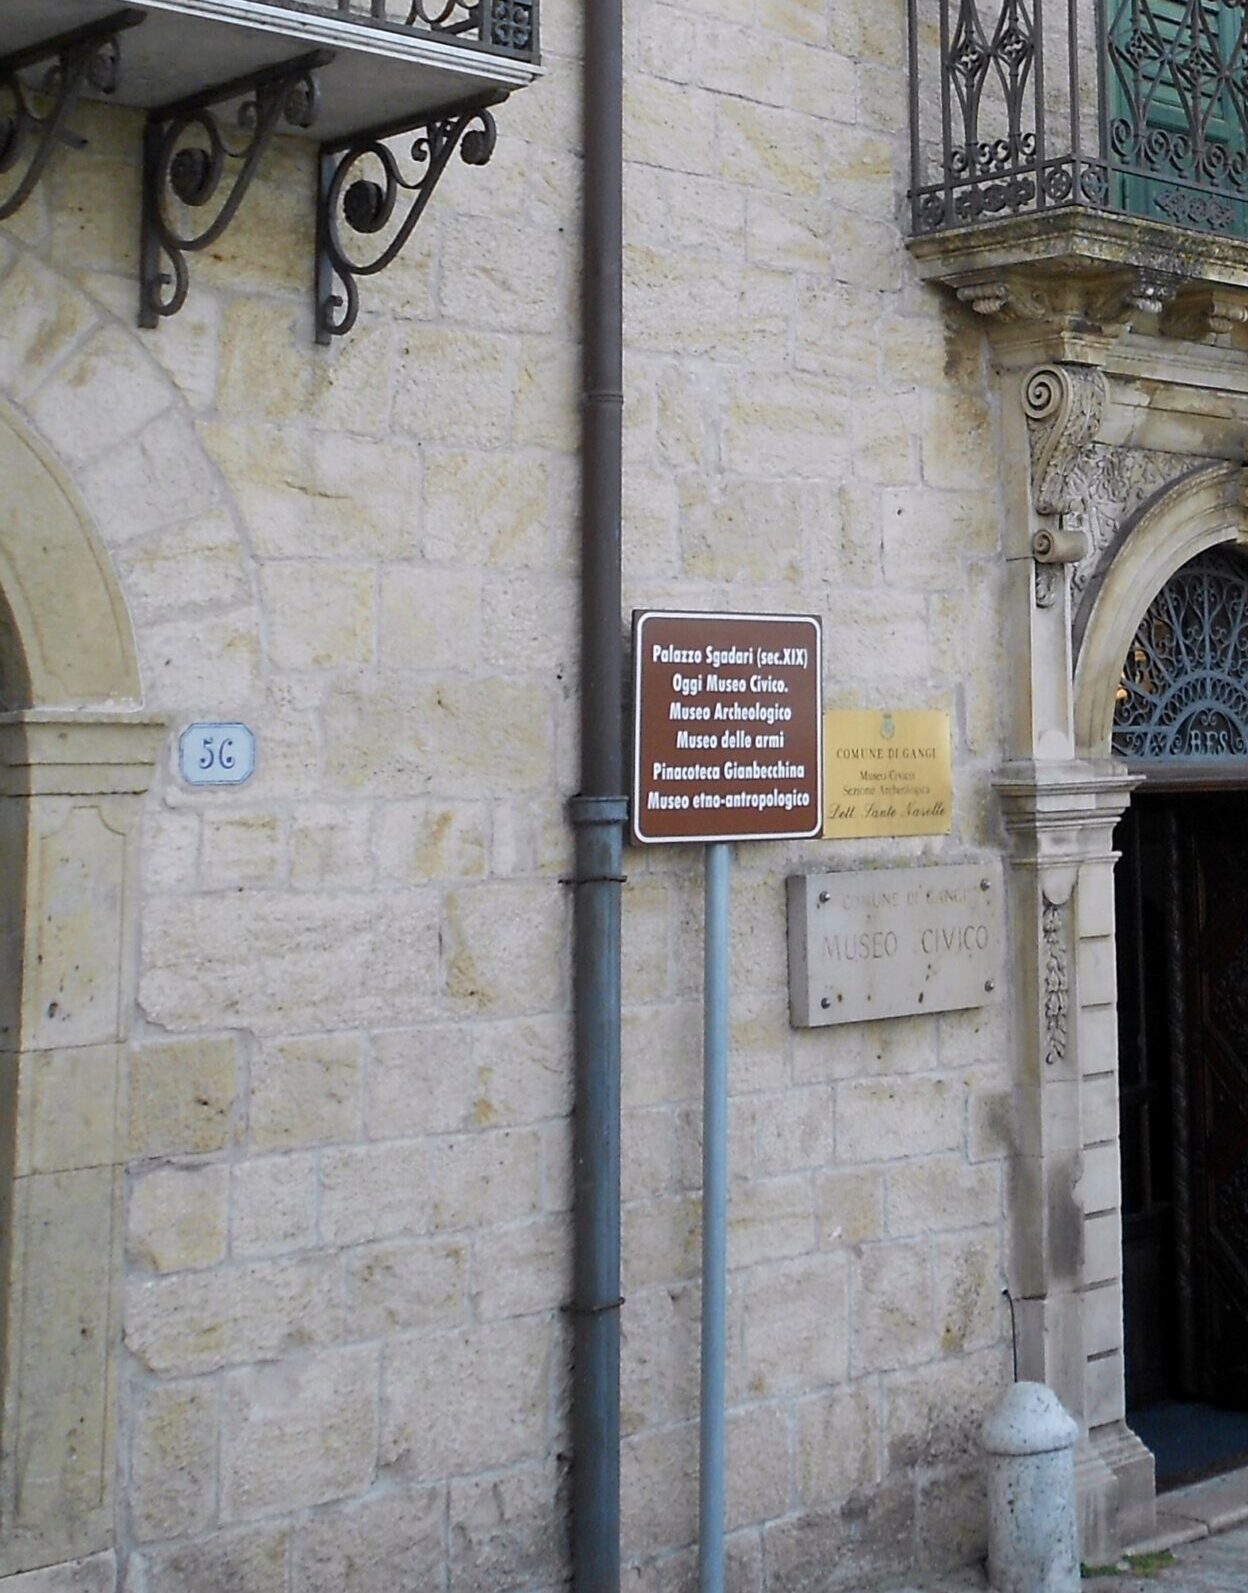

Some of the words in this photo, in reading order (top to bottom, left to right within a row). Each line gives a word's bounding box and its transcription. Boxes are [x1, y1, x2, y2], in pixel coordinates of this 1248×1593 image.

[652, 644, 702, 663] Palazzo
[705, 645, 753, 668] Sgadari
[756, 647, 808, 669] (sec.XIX)
[672, 673, 702, 696] Oggi
[706, 674, 746, 692] Museo
[750, 675, 788, 693] Civico.
[669, 702, 710, 720] Museo
[714, 702, 792, 724] Archeologico
[676, 731, 717, 748] Museo
[721, 730, 751, 748] delle
[755, 731, 784, 748] armi
[199, 737, 235, 769] 56
[837, 748, 884, 759] COMUNE
[888, 748, 899, 759] DI
[902, 747, 936, 759] GANGI
[653, 762, 721, 780] Pinacoteca
[724, 760, 805, 779] Gianbecchina
[860, 770, 887, 781] Museo
[889, 769, 915, 780] Civico
[647, 791, 689, 809] Museo
[693, 788, 810, 811] etno-antropologico
[843, 785, 876, 796] Sezione
[823, 931, 898, 961] MUSEO
[921, 924, 988, 954] CIVICO
